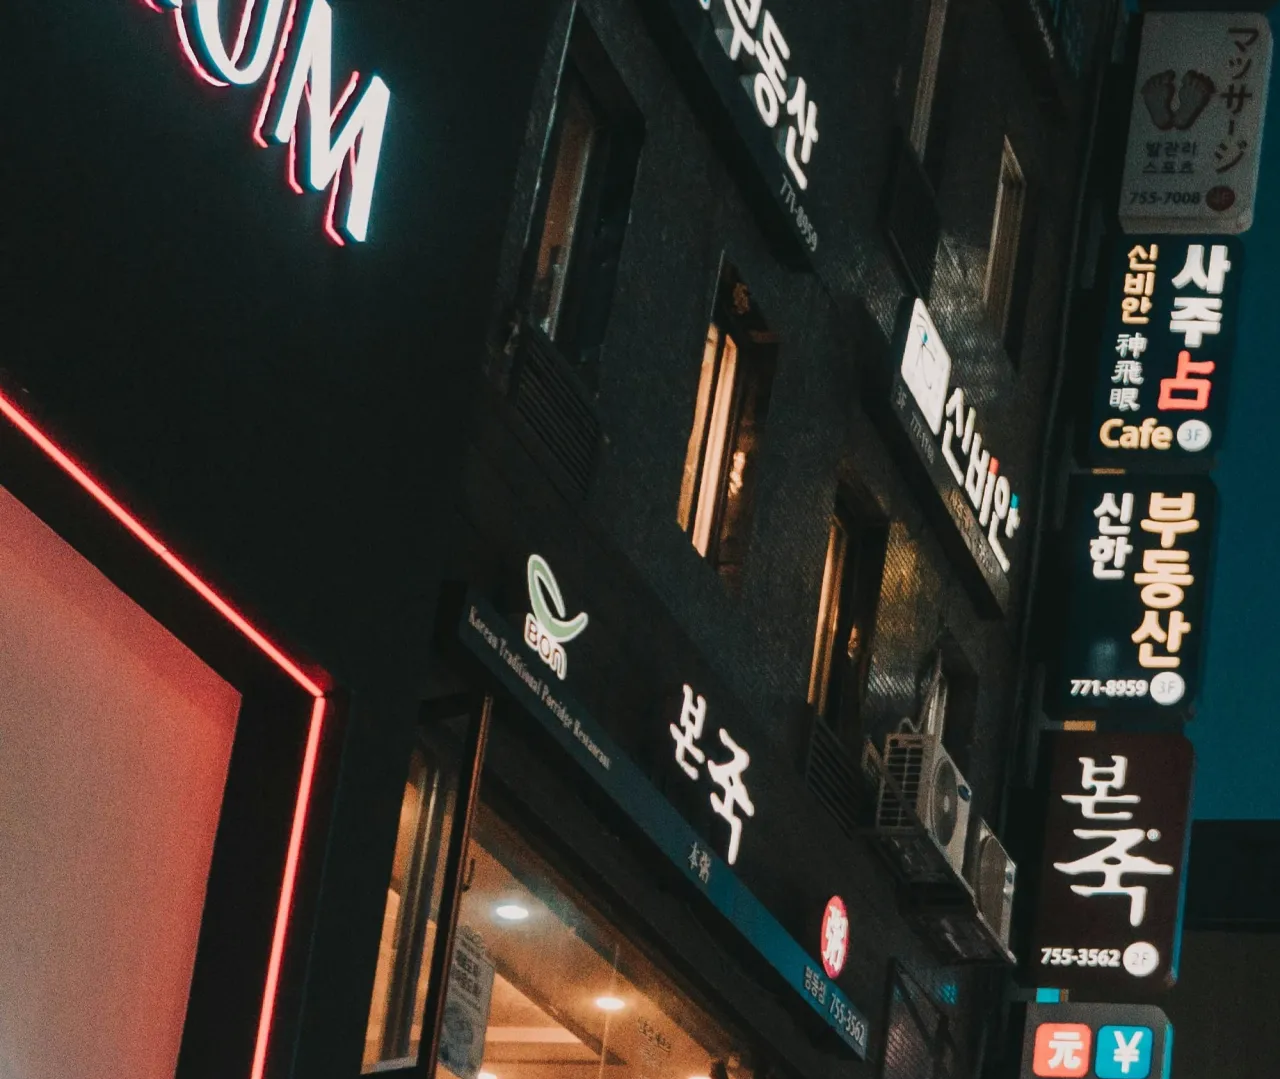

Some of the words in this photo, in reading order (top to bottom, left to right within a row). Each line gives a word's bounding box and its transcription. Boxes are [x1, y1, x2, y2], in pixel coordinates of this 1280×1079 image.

[1215, 27, 1260, 174] マッサージ
[1121, 244, 1159, 325] 신비안
[1100, 417, 1174, 450] Cafe
[945, 387, 1021, 573] 신비안
[1089, 492, 1134, 580] 신한
[1131, 492, 1200, 668] 부동산
[1070, 678, 1149, 697] 771-8959
[669, 683, 756, 866] 본죽
[1053, 755, 1174, 927] 본죽
[1040, 947, 1121, 967] 755-3562
[1048, 1031, 1083, 1069] 元
[1113, 1030, 1143, 1074] ¥
